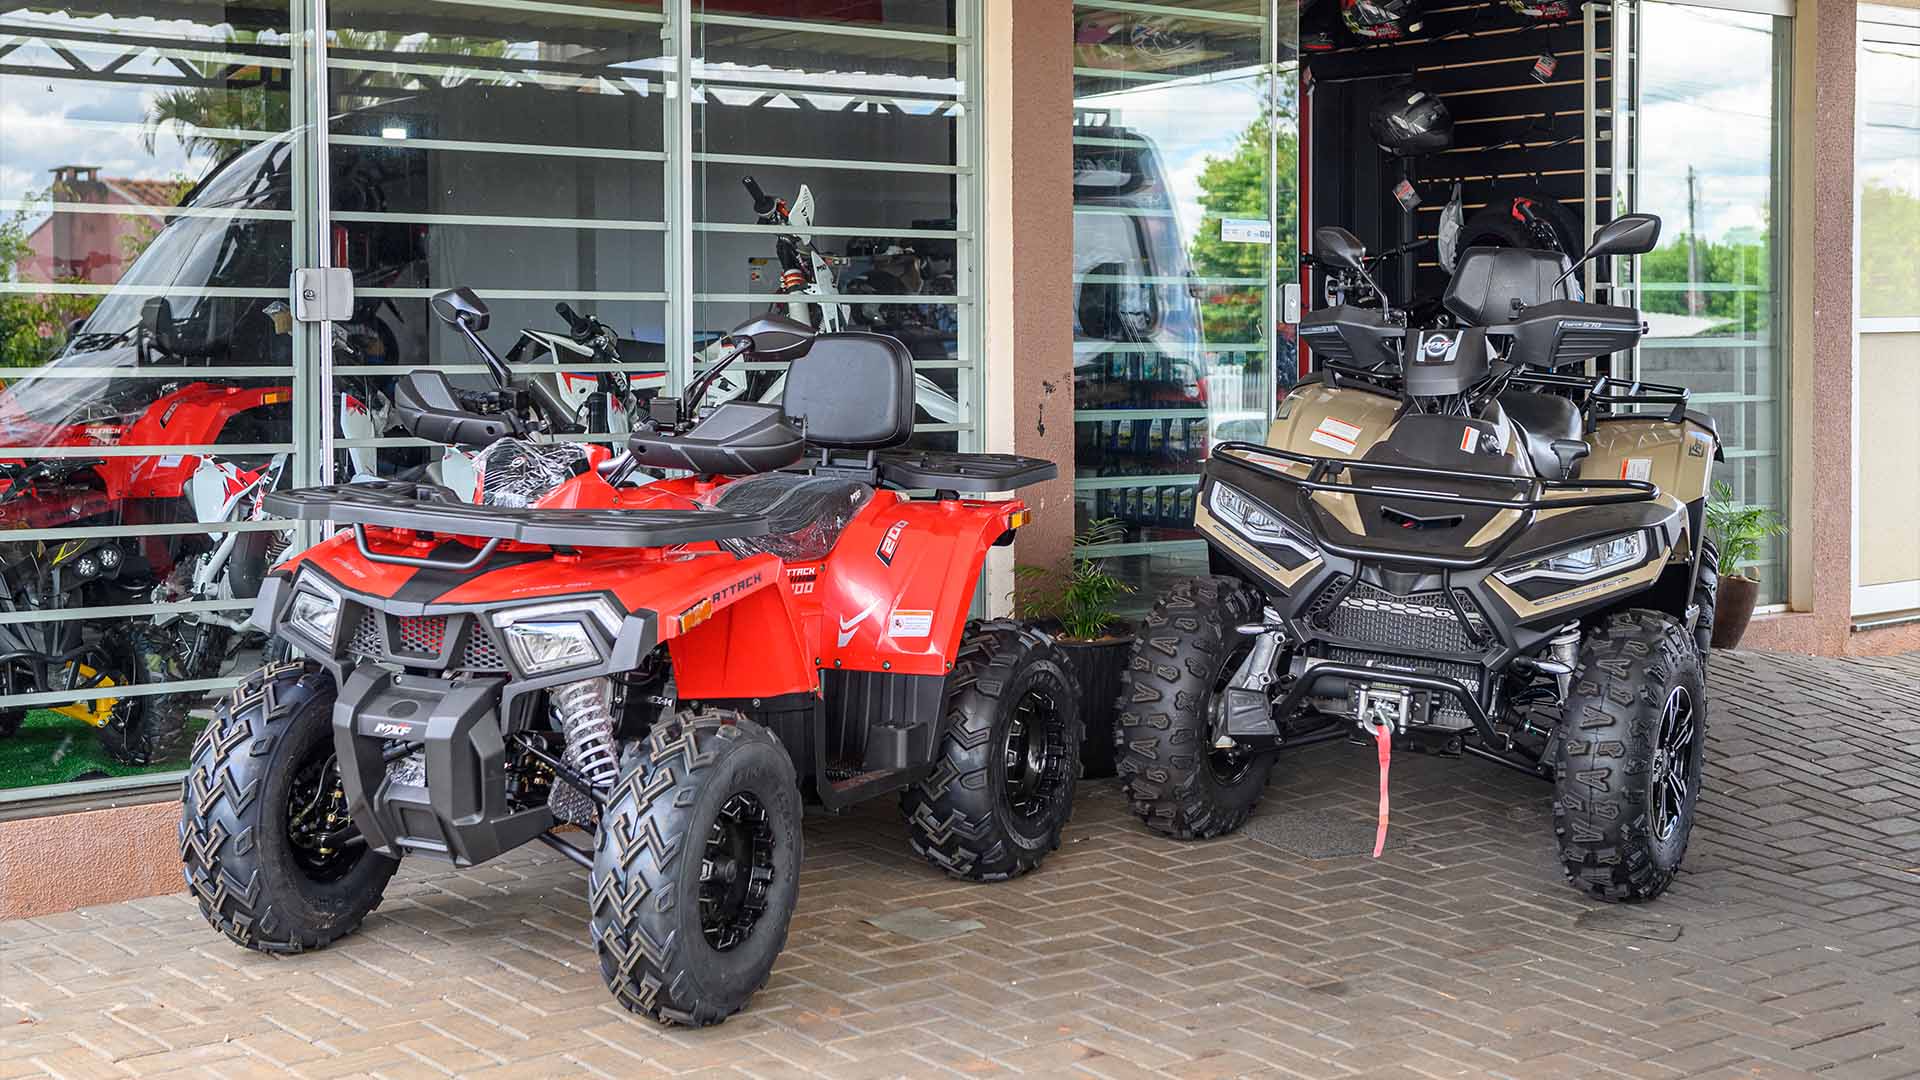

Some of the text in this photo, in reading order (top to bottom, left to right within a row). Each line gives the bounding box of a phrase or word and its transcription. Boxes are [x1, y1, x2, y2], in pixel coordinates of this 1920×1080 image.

[881, 520, 909, 555] 200
[785, 567, 815, 577] TTACK
[712, 571, 762, 604] ATTACK
[791, 582, 814, 595] 00
[374, 722, 412, 736] MXF
